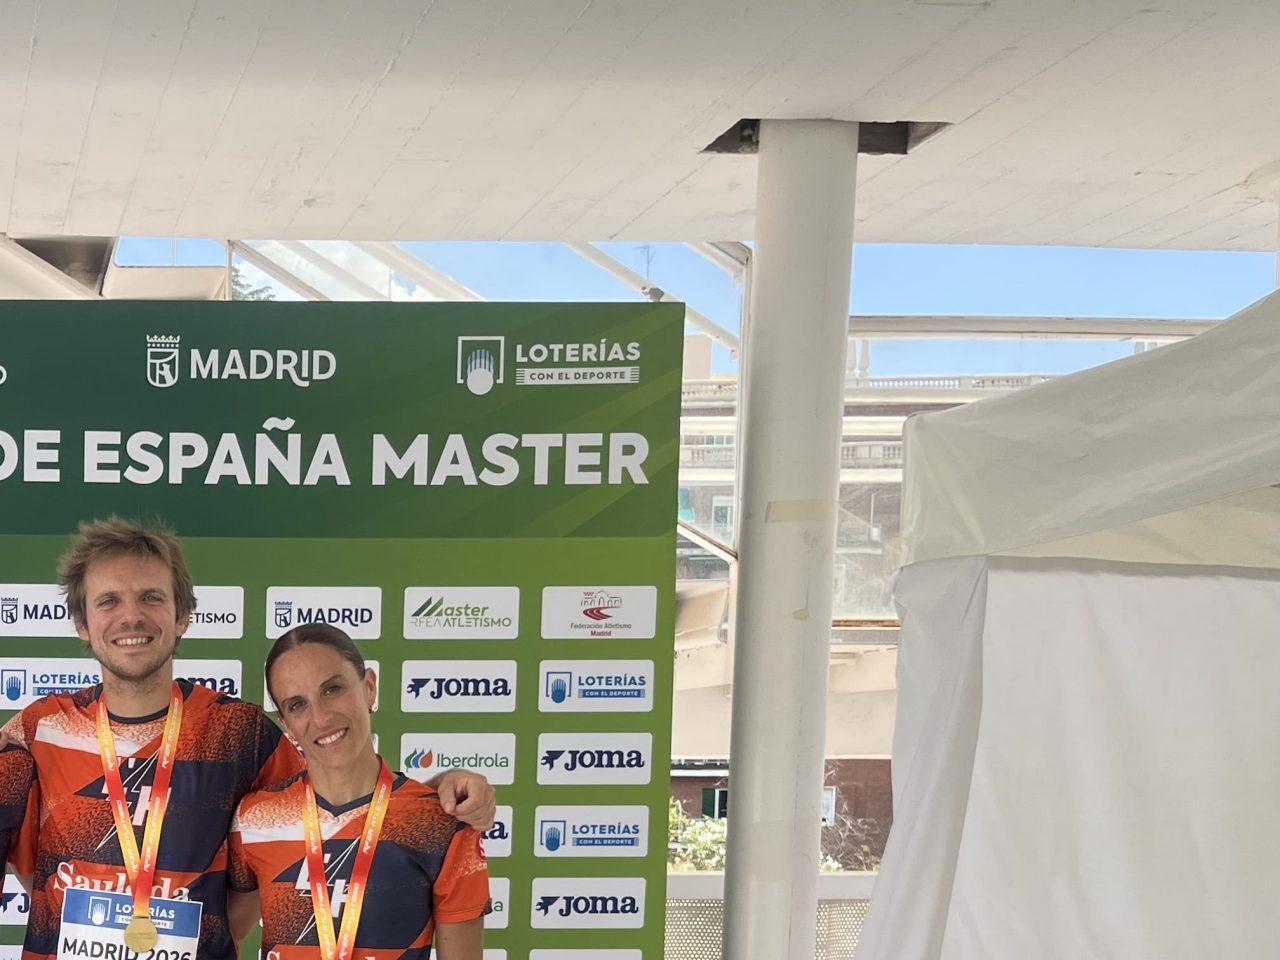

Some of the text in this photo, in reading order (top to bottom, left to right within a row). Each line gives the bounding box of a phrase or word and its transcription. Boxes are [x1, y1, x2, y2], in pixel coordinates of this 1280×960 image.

[516, 339, 641, 363] LOTERÍAS
[190, 349, 337, 387] MADRID
[529, 370, 626, 381] CON EL DEPORTE
[83, 416, 351, 486] ESPAÑA
[372, 431, 650, 487] MASTER
[24, 604, 71, 619] MAD
[297, 608, 372, 626] MADRID
[442, 617, 512, 628] ATLETISMO
[32, 672, 100, 684] LOTERÍAS
[578, 673, 646, 686] LOTERÍAS
[436, 752, 509, 768] Iberdrola
[572, 822, 640, 834] LOTERÍAS
